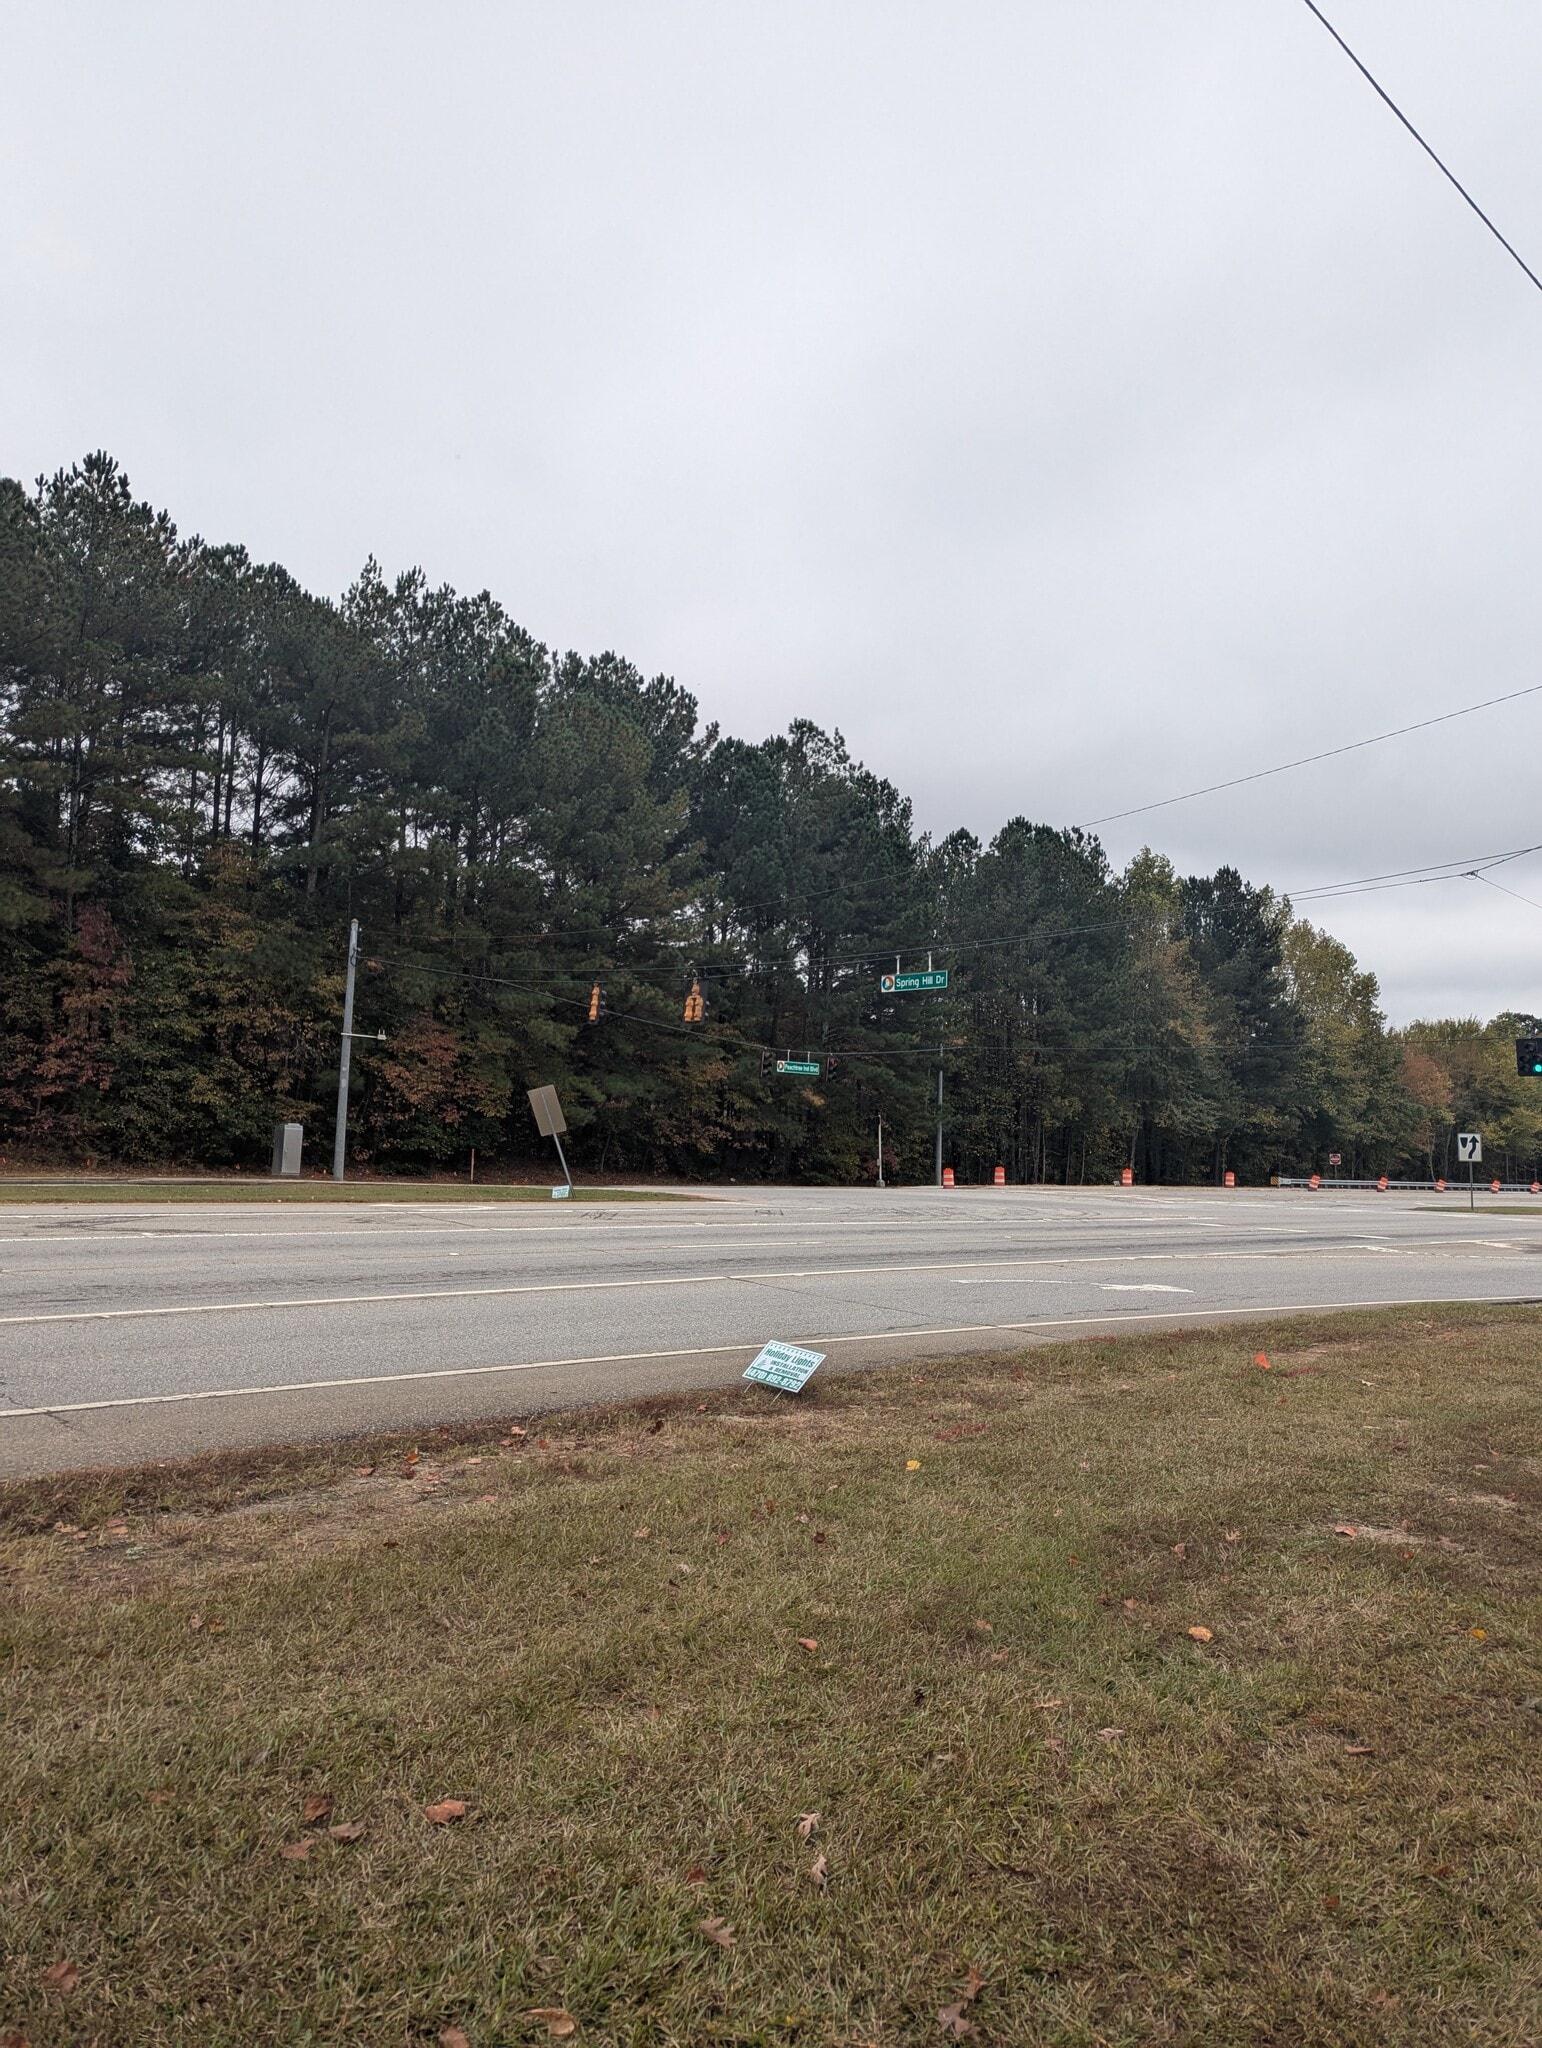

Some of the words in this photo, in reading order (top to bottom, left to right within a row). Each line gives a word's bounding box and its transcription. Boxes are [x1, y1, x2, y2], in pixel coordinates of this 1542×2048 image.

[896, 977, 919, 988] Spring
[922, 976, 933, 985] Hill
[936, 975, 945, 984] Dr
[765, 1348, 790, 1362] Holiday
[791, 1355, 815, 1368] Lights
[770, 1360, 809, 1374] INSTALLATION
[775, 1367, 801, 1378] REMOVAL
[747, 1368, 766, 1380] (470)
